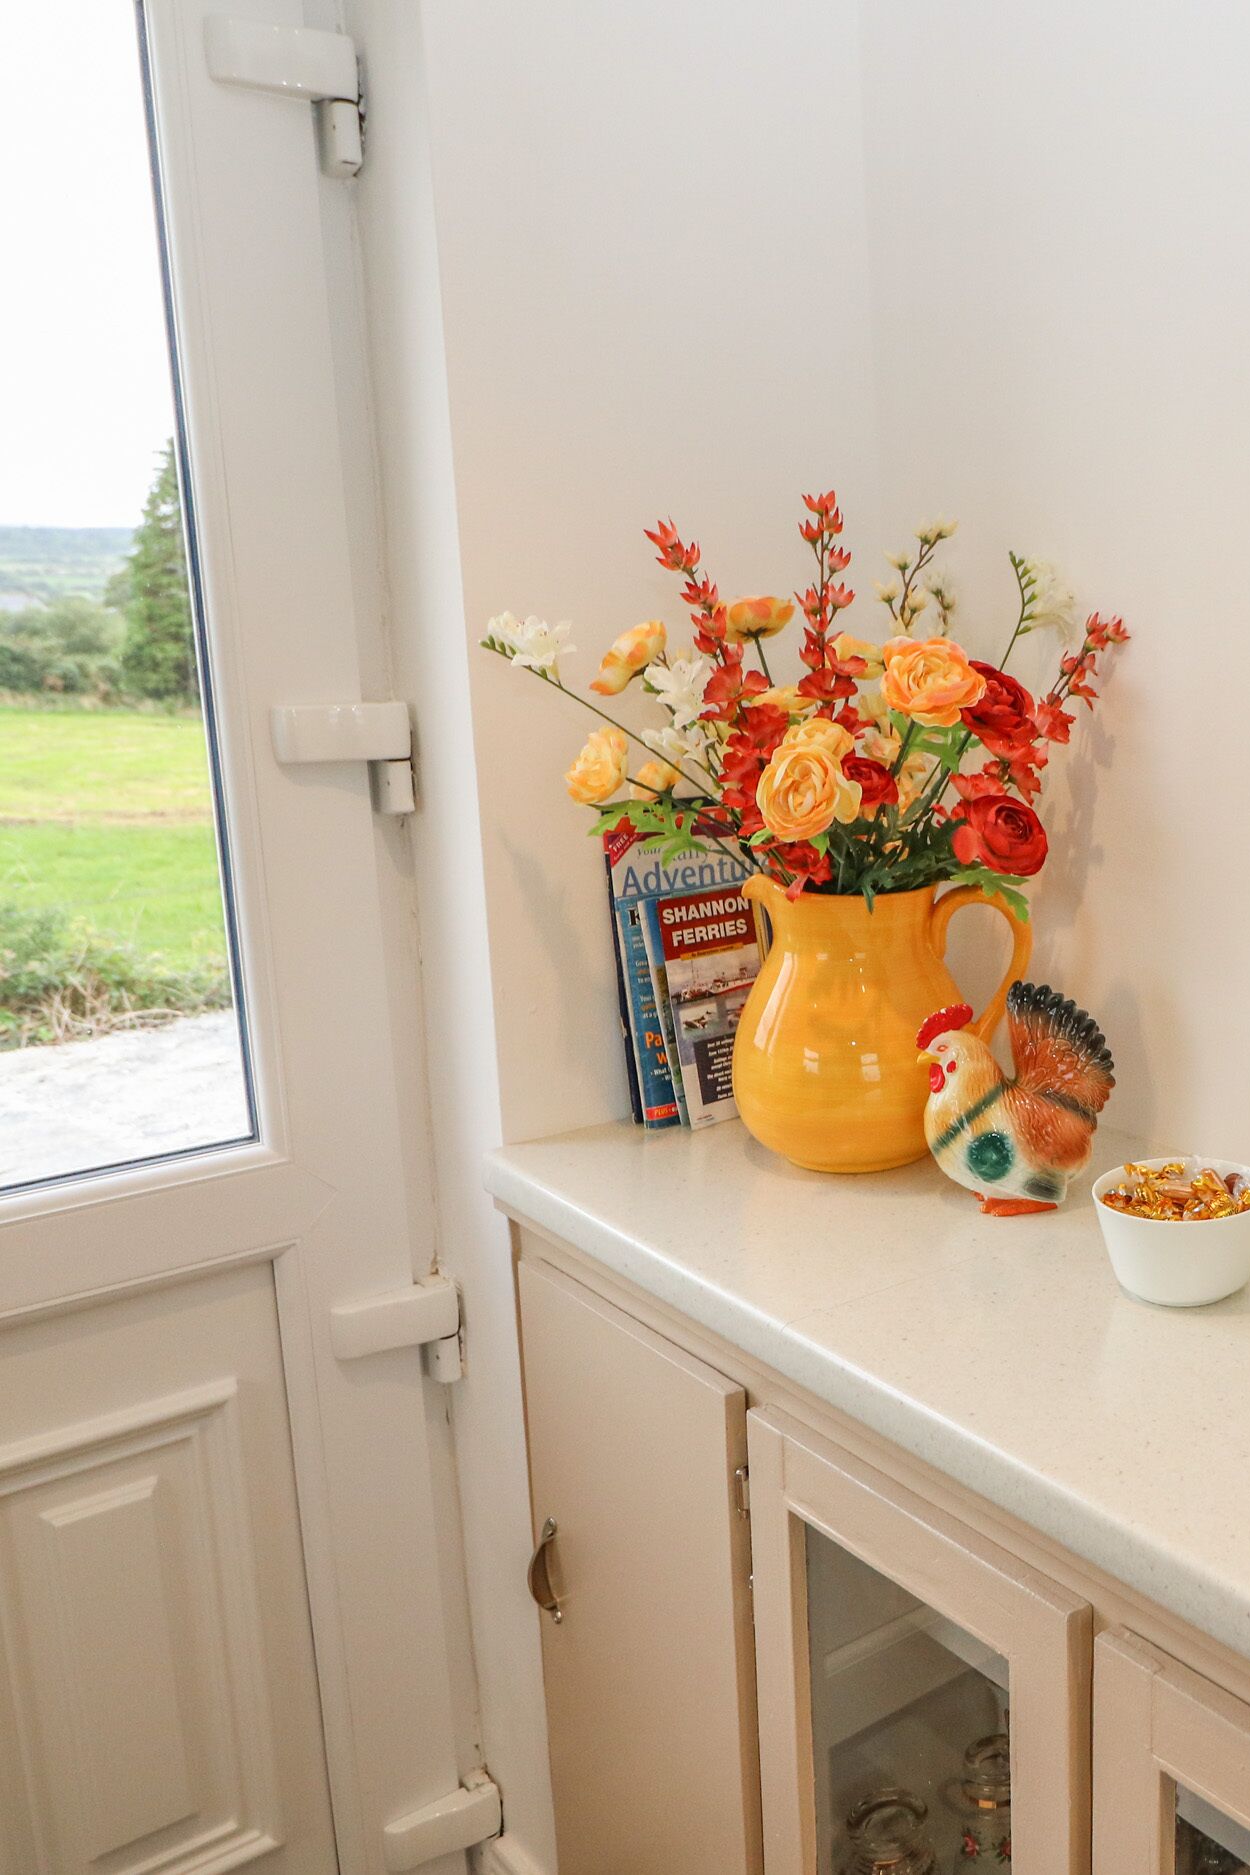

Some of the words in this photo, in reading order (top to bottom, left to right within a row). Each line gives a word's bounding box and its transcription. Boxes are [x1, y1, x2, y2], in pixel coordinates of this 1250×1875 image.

[622, 855, 768, 898] Adventu
[662, 896, 749, 925] SHANNON
[671, 918, 748, 947] FERRIES
